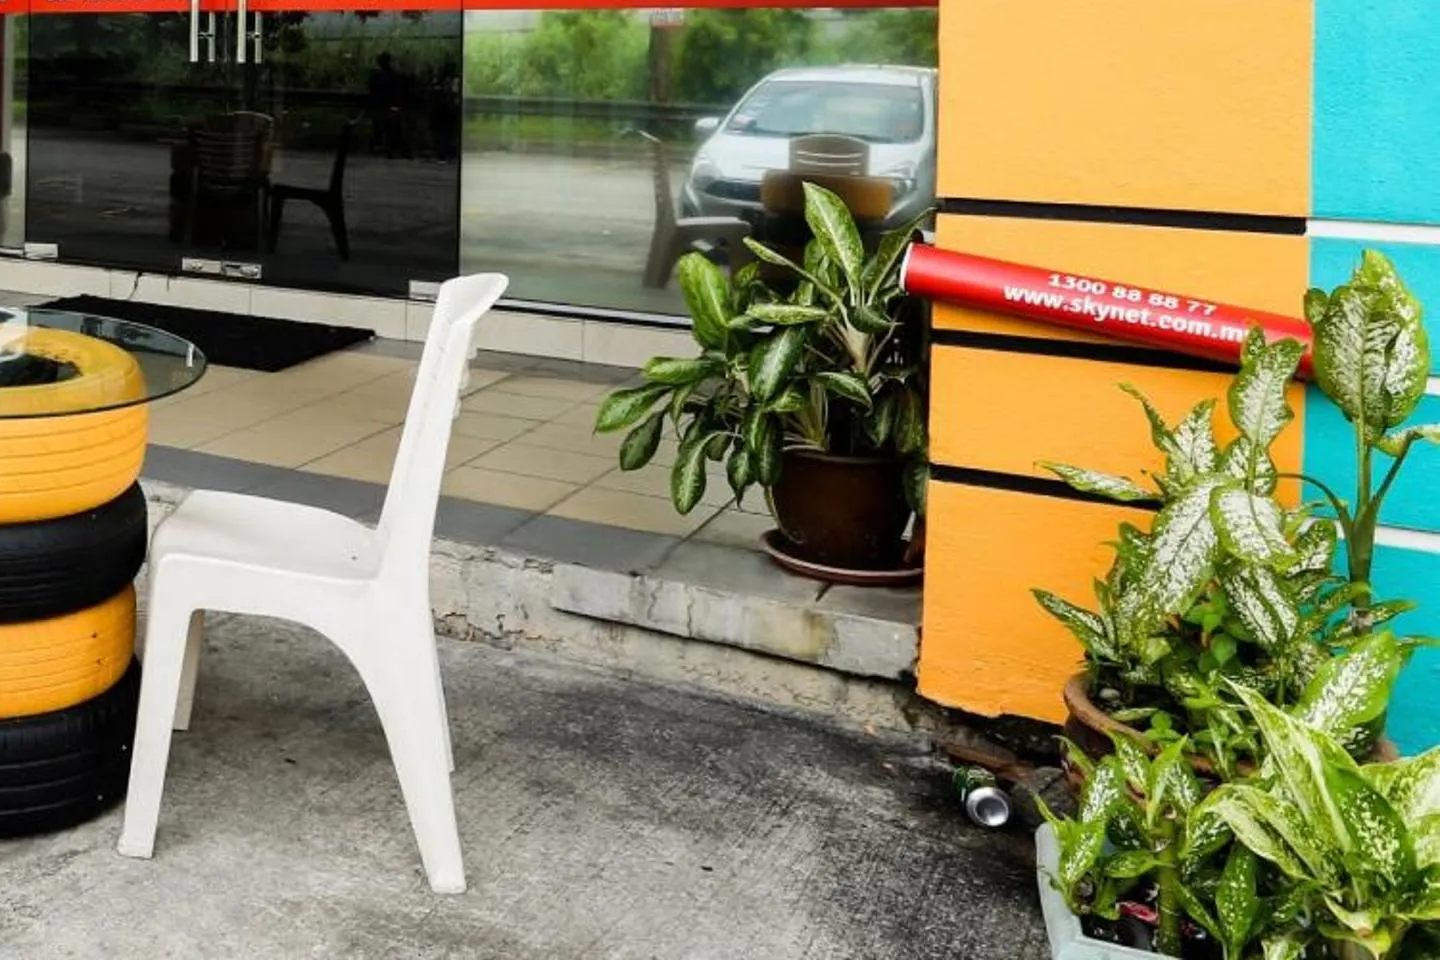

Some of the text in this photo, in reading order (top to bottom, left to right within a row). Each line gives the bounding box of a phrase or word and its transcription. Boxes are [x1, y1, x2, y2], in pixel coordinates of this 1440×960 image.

[1047, 273, 1218, 316] 1300 88 88 77
